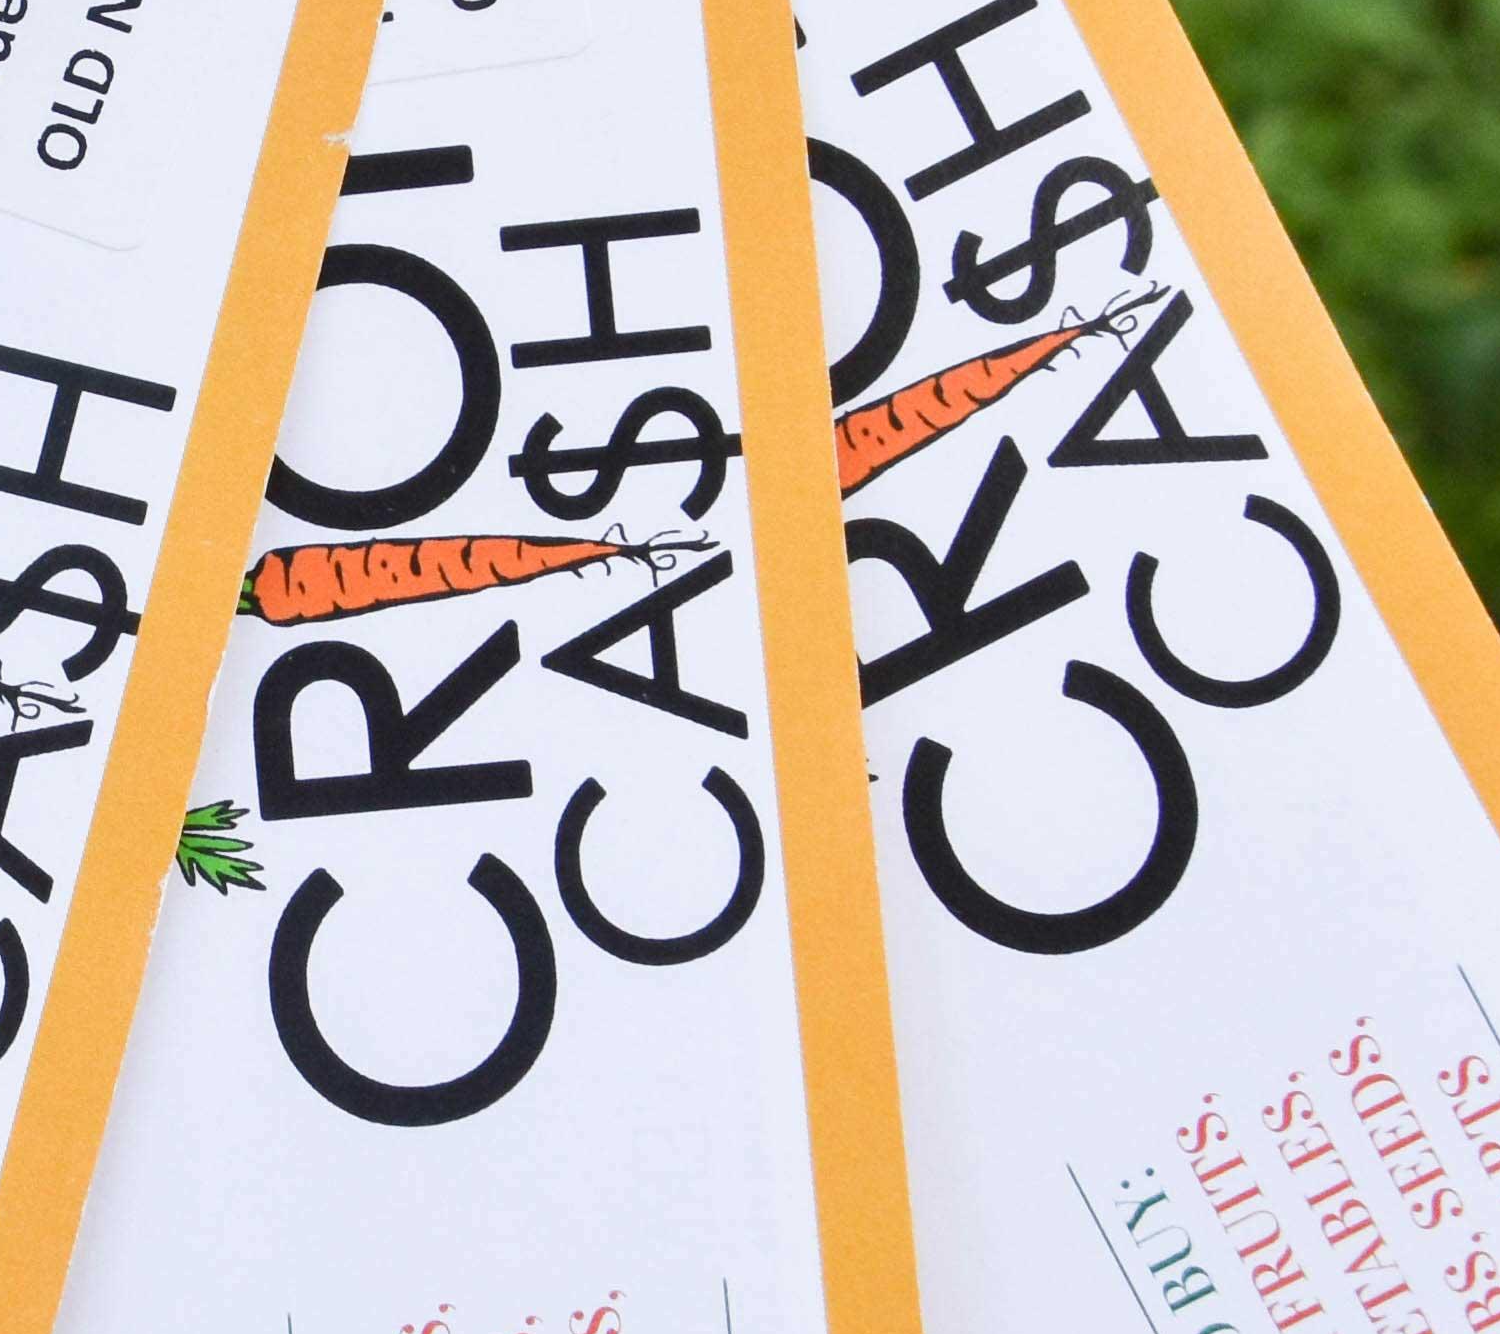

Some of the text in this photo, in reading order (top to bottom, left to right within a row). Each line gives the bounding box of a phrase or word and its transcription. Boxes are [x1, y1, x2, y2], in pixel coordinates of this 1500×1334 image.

[36, 48, 115, 171] OLD
[498, 205, 766, 967] CA$H
[1176, 1092, 1324, 1332] FRUITS,
[1328, 1015, 1464, 1230] SEEDS,
[1113, 1167, 1218, 1315] BUY:
